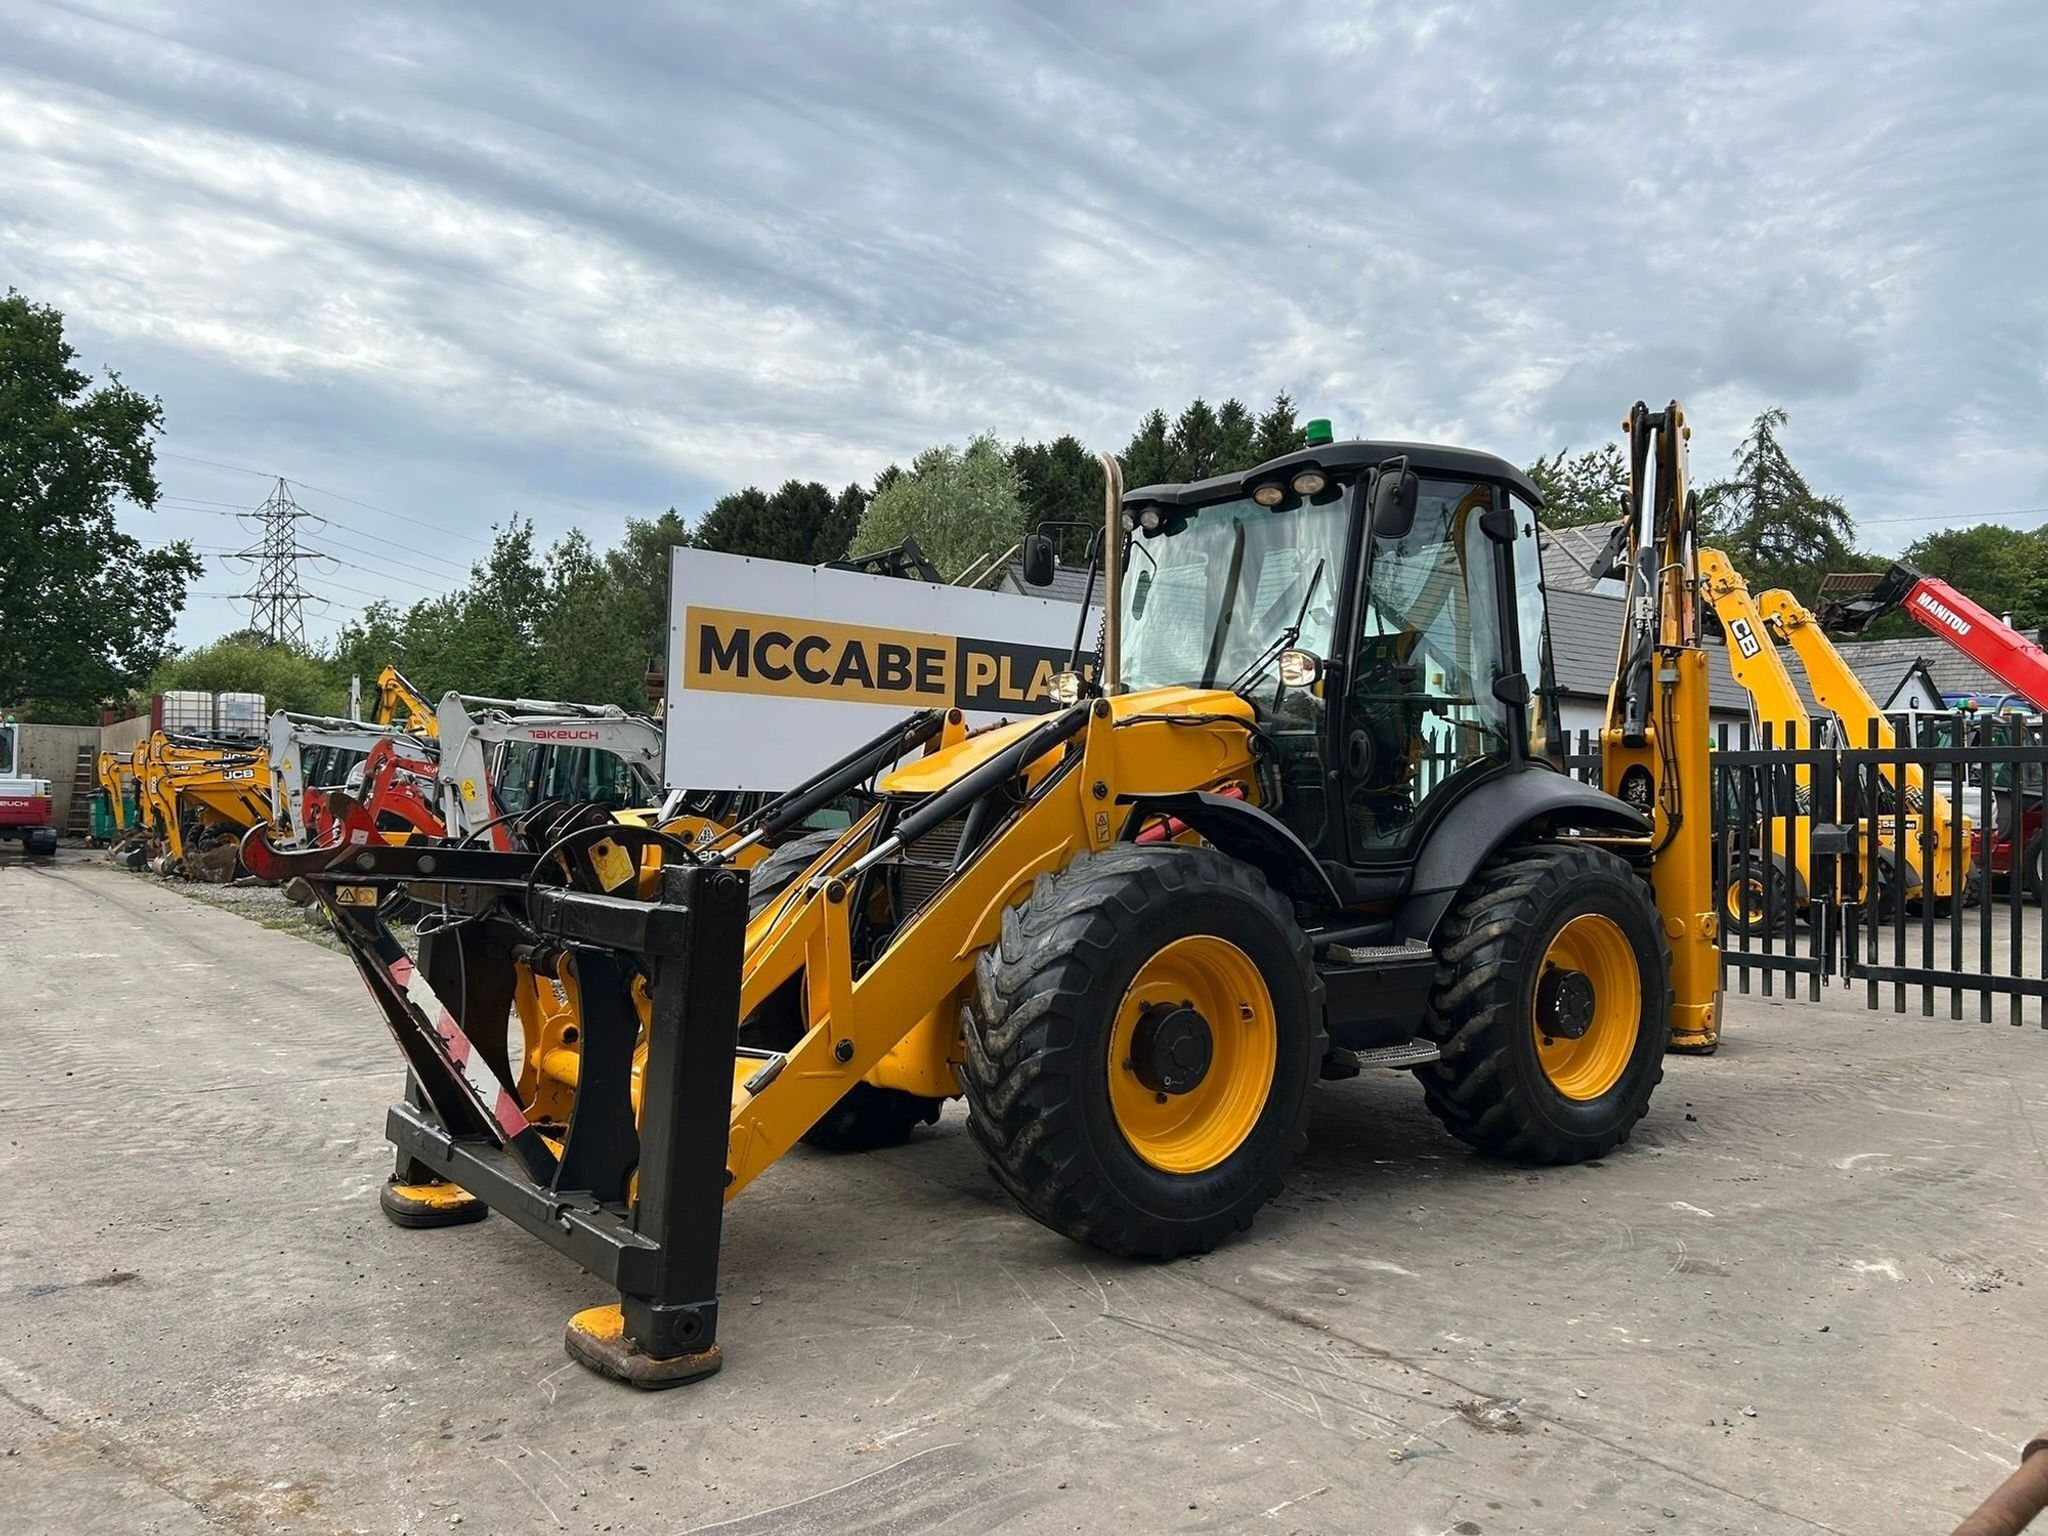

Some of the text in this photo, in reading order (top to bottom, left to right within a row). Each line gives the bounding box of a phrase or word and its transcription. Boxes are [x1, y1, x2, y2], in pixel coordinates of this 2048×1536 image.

[1916, 592, 1972, 635] MANITOU
[699, 624, 947, 694] MCCABE
[224, 769, 254, 780] JCB
